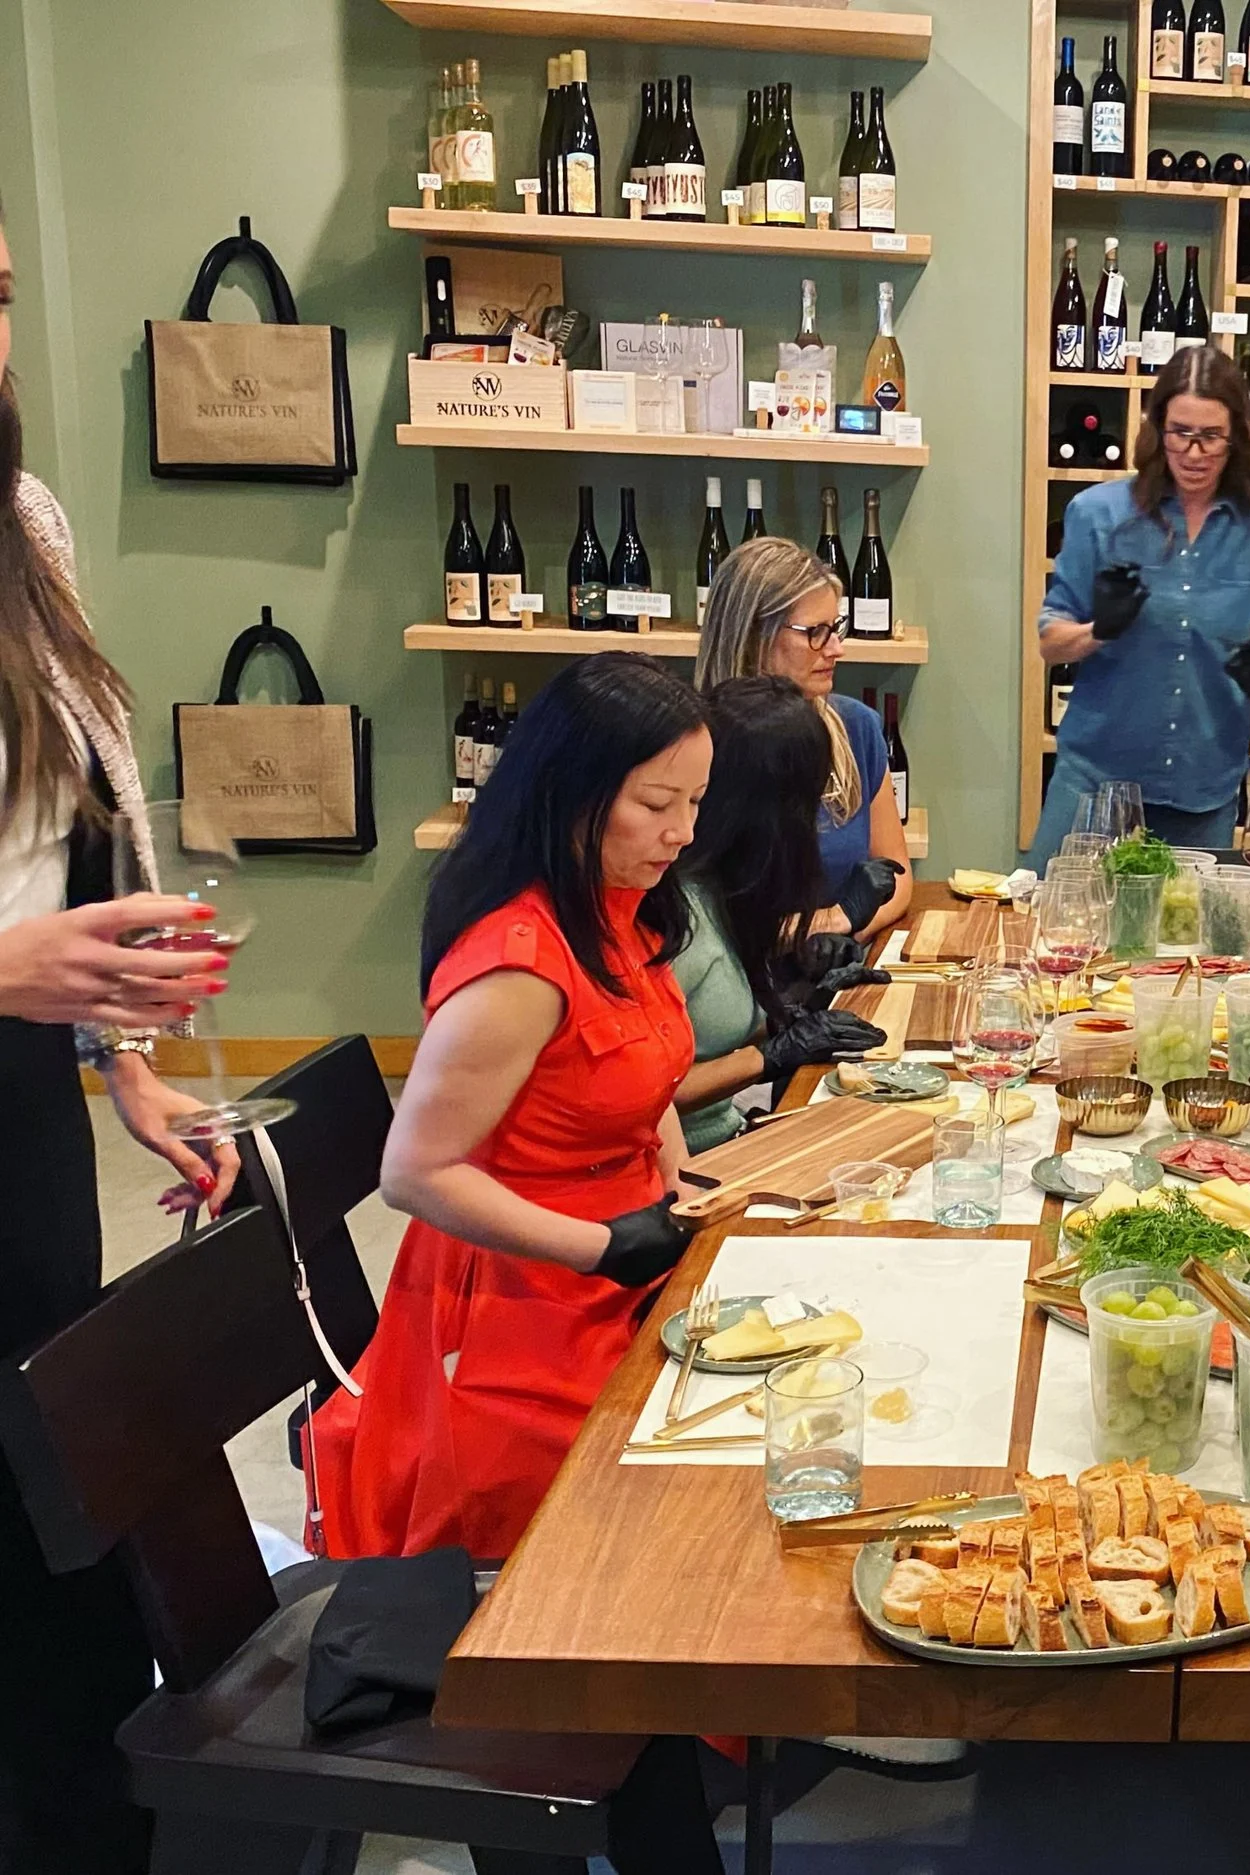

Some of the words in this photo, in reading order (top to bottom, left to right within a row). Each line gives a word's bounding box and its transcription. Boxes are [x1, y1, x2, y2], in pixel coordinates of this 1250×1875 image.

[616, 339, 684, 354] GLASVIN
[197, 404, 267, 418] NATURE'S
[271, 405, 297, 418] VIN
[437, 402, 509, 417] NATURE'S
[514, 405, 541, 419] VIN
[221, 784, 288, 797] NATURE'S
[292, 783, 317, 795] VIN
